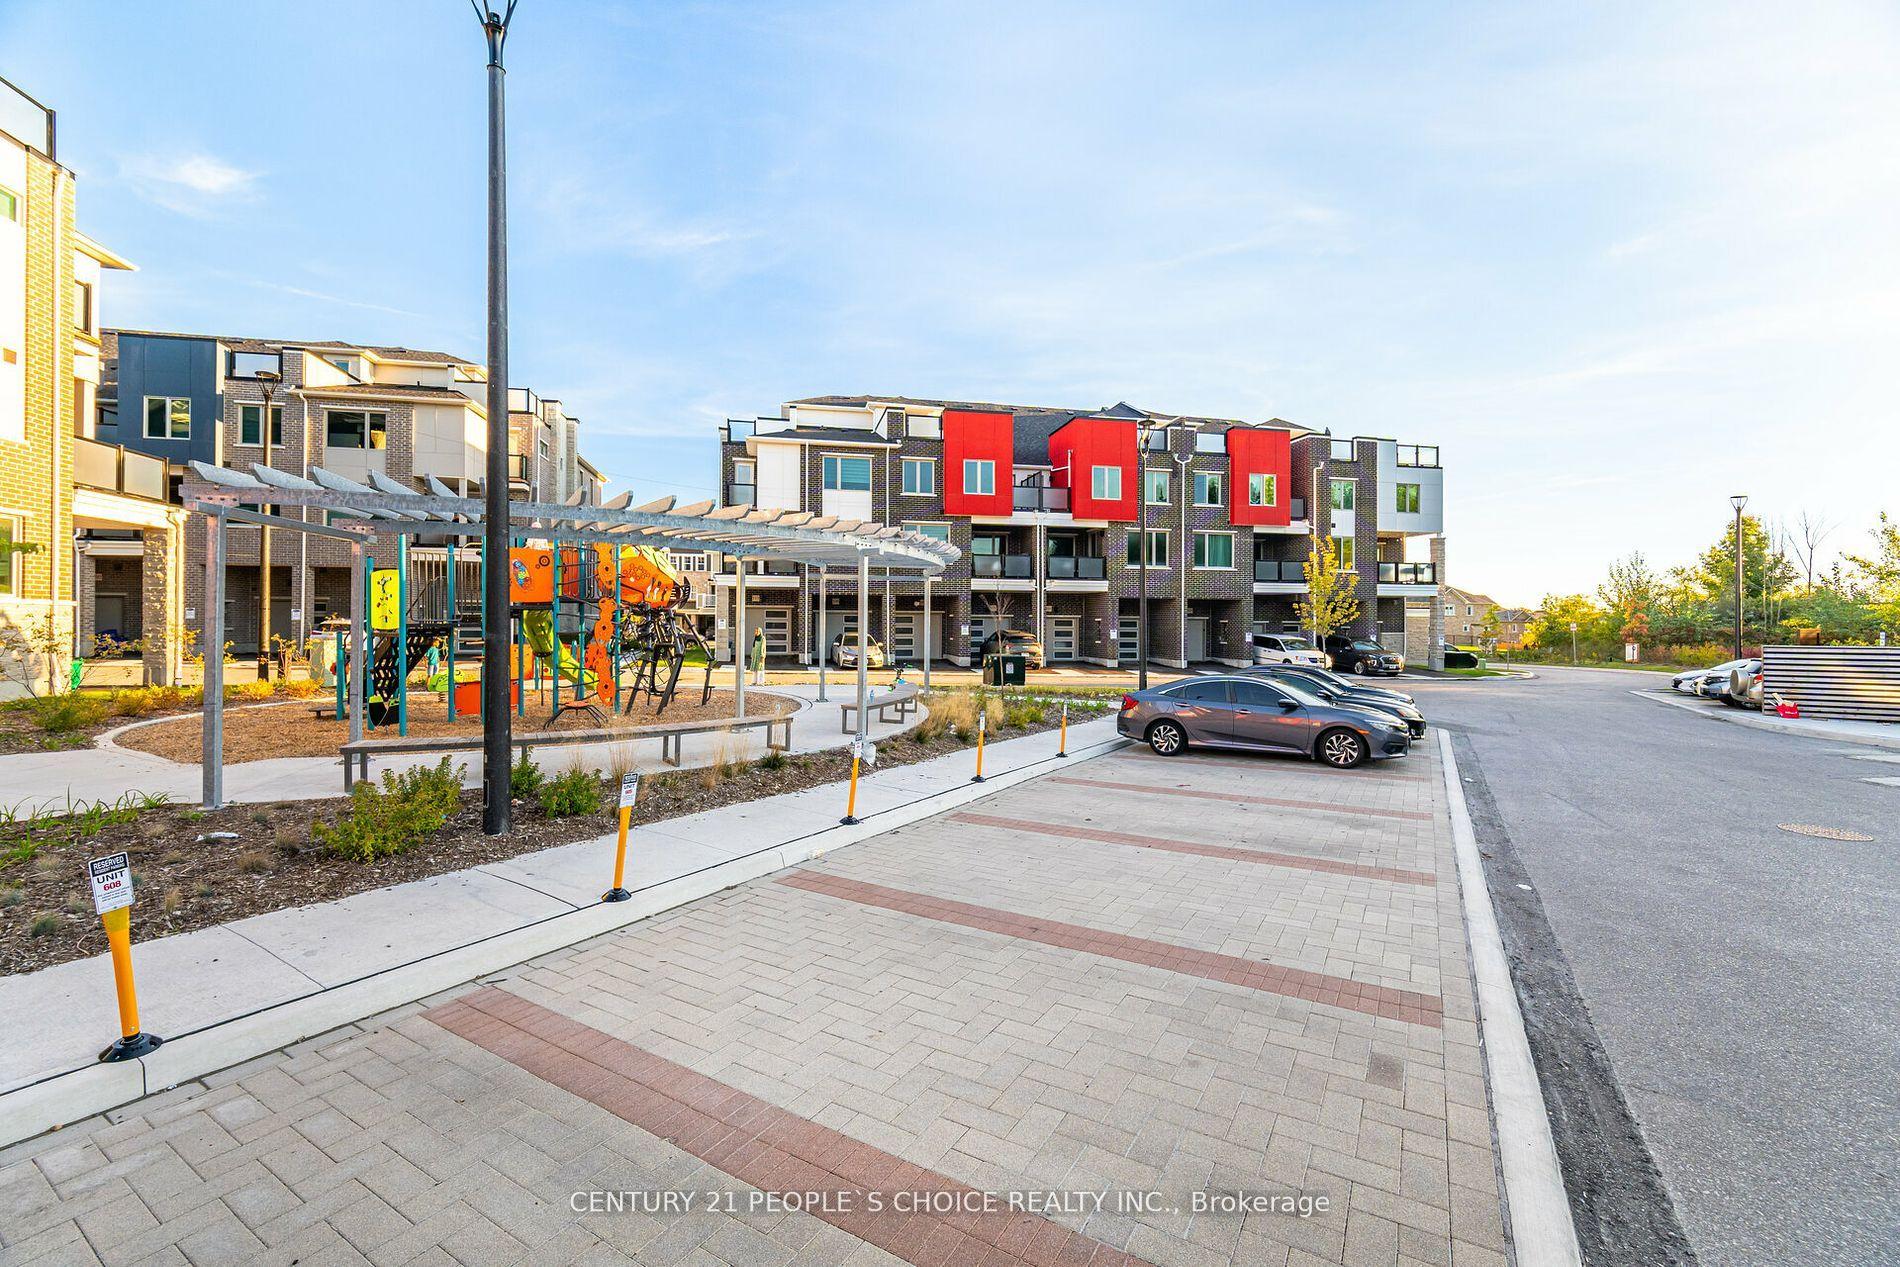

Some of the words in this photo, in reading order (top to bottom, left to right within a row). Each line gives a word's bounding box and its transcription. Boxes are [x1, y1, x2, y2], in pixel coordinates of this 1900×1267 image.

[94, 856, 124, 871] RESERVED
[97, 870, 125, 883] UNIT
[103, 881, 121, 890] 608
